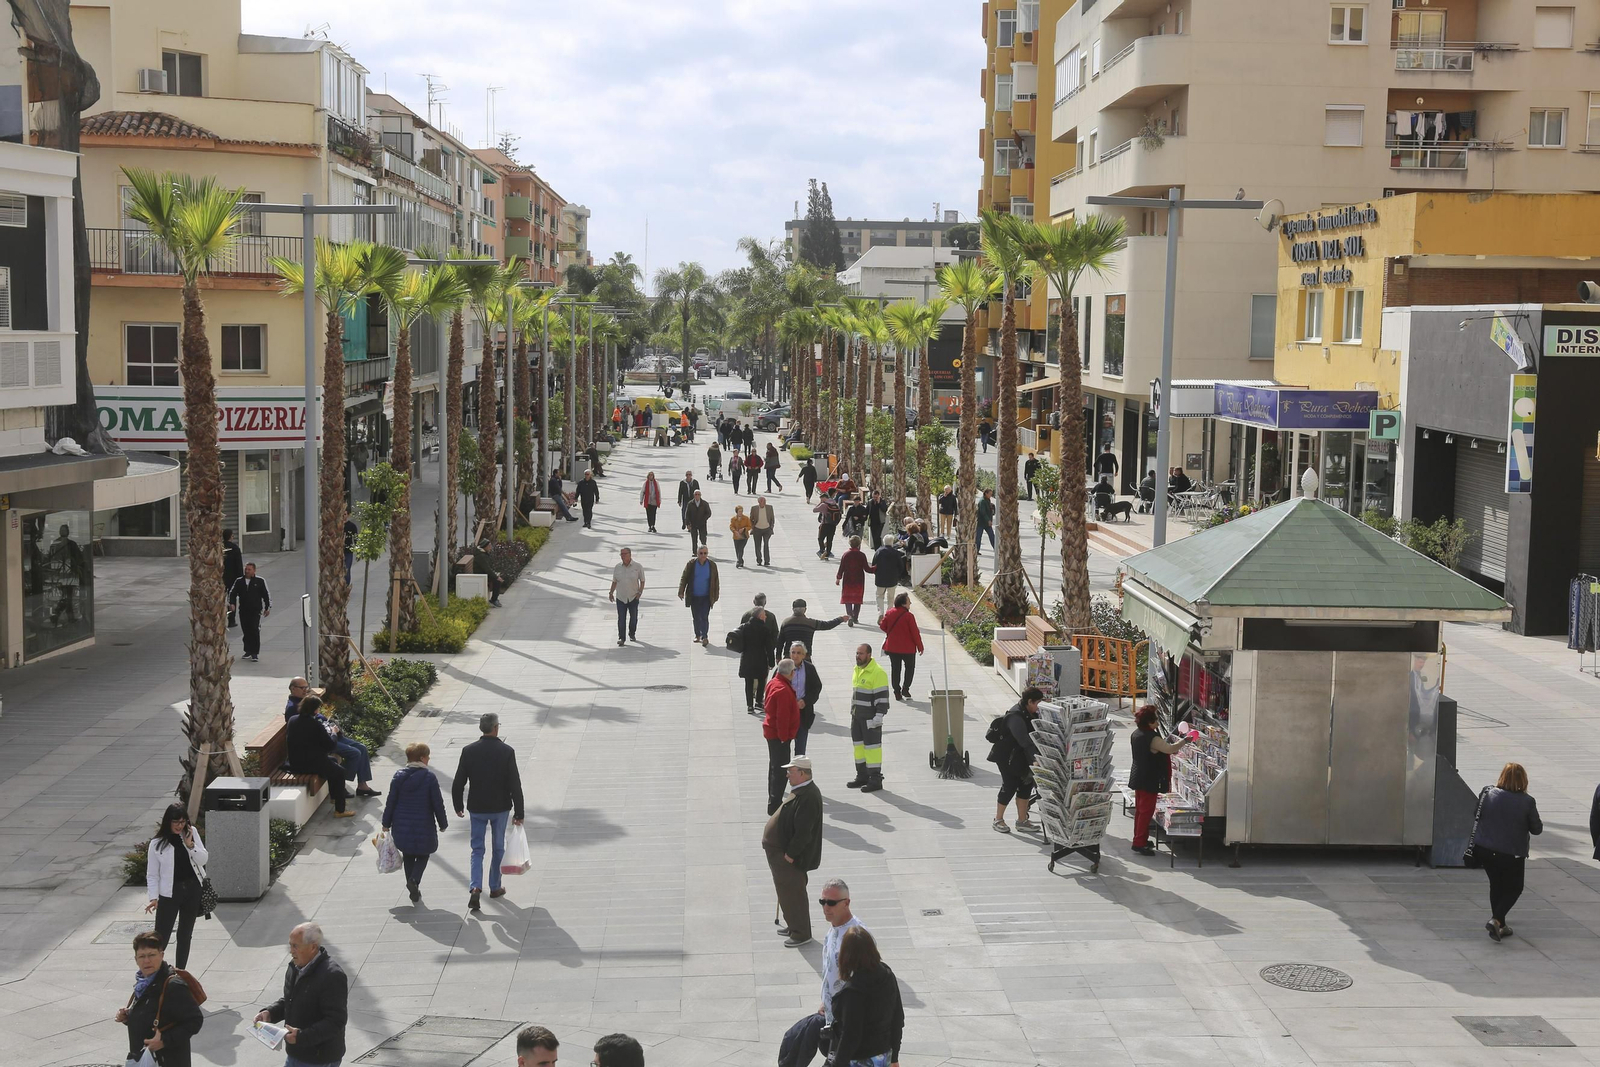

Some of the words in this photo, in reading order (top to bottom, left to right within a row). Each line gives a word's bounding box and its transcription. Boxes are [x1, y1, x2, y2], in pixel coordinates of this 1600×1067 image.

[1317, 203, 1377, 230] inmobiliaria
[1291, 241, 1319, 262] COSTA
[1322, 240, 1342, 260] DEL
[1344, 236, 1364, 257] SOL
[1300, 266, 1320, 286] real
[1322, 264, 1352, 284] estate
[1557, 329, 1599, 344] DIS
[1226, 392, 1243, 415] Pura
[1244, 394, 1271, 420] Dehesa
[1298, 400, 1329, 413] Pura
[1332, 400, 1377, 414] Dehesa
[1376, 415, 1397, 436] P
